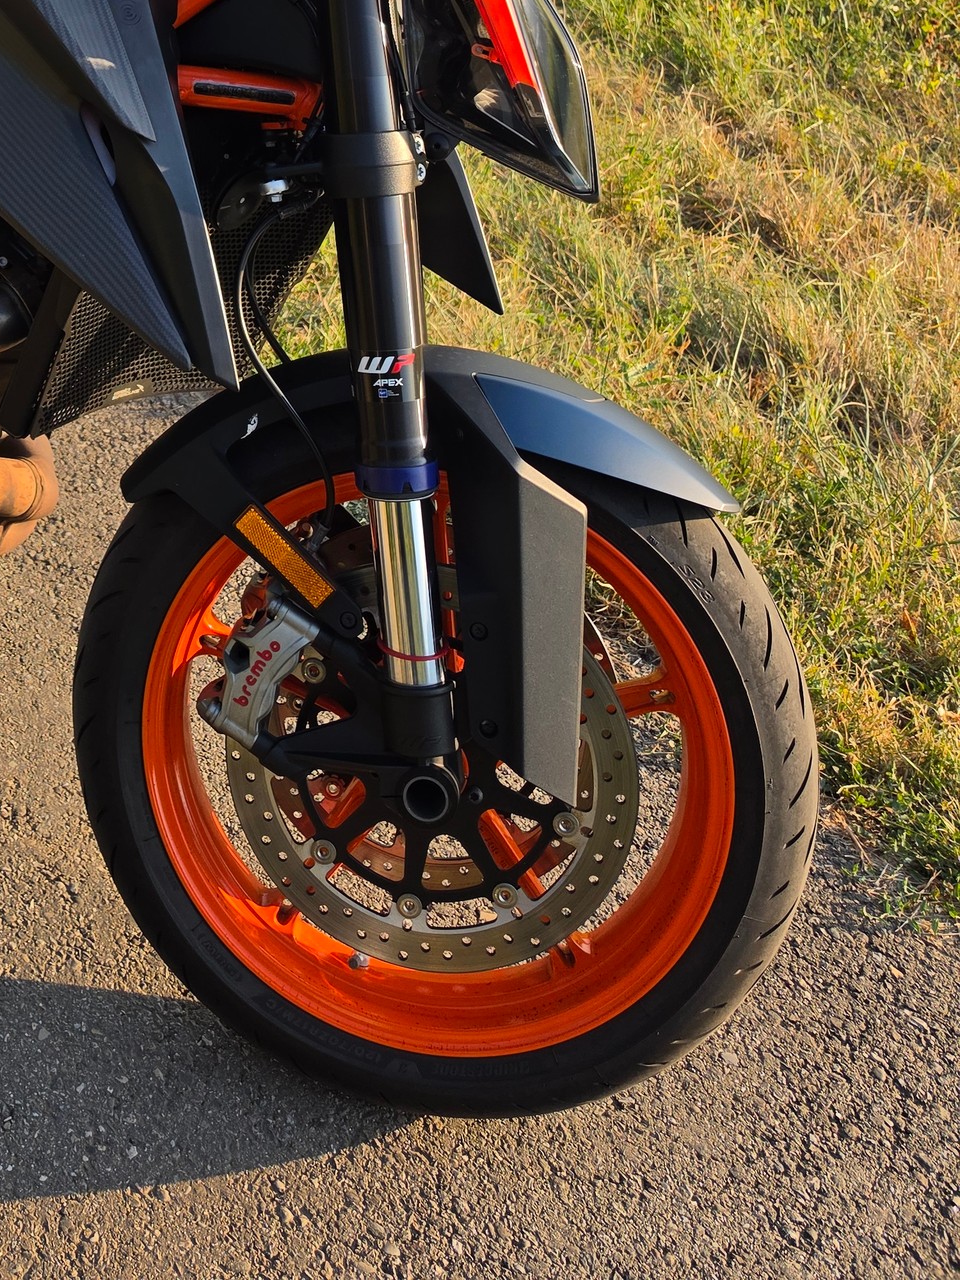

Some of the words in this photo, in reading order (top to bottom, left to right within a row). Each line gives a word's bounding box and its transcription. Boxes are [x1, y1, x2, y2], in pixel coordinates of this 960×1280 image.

[358, 353, 416, 374] WP
[373, 378, 404, 387] APEX
[233, 640, 281, 707] brembo
